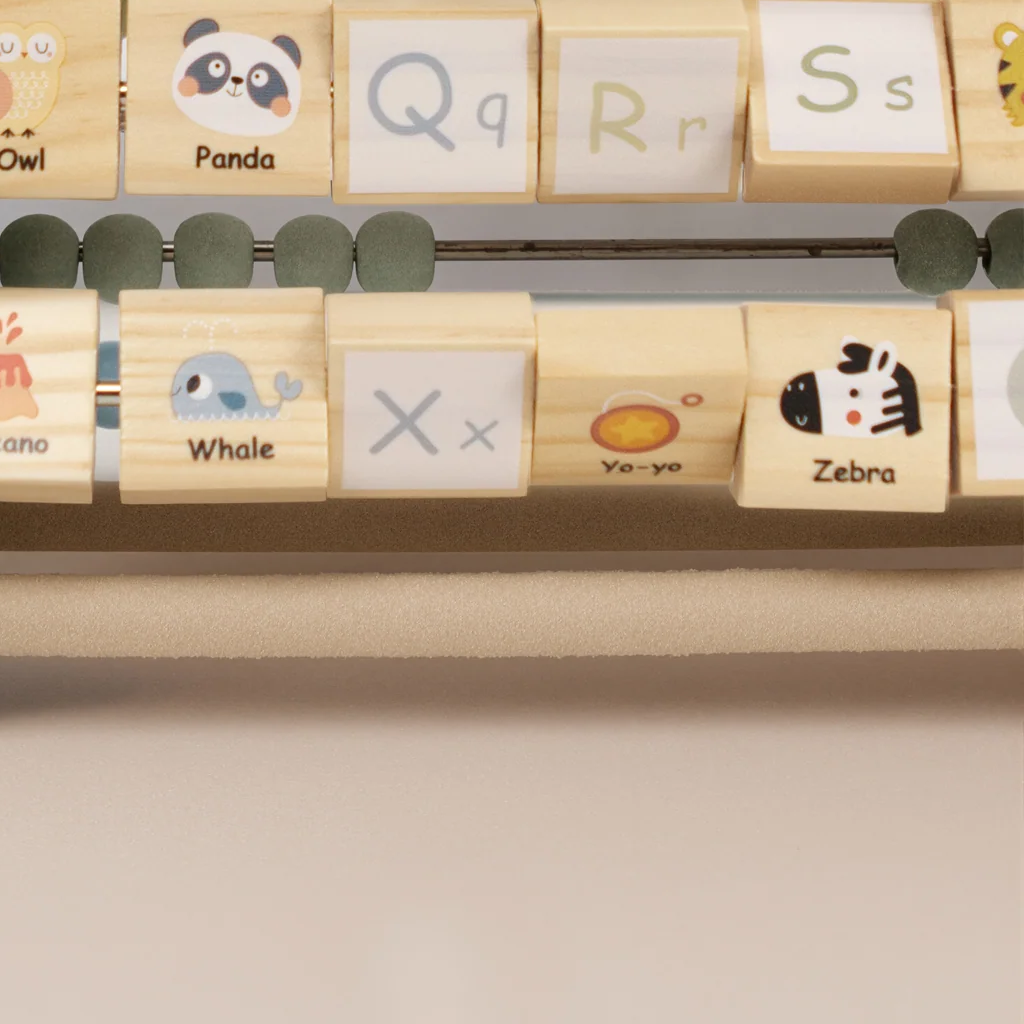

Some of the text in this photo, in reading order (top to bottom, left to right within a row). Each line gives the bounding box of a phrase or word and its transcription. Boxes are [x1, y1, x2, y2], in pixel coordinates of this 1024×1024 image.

[195, 145, 275, 170] Panda
[187, 436, 275, 462] Whale
[601, 460, 683, 477] Yo-yo
[813, 459, 896, 484] Zebra
